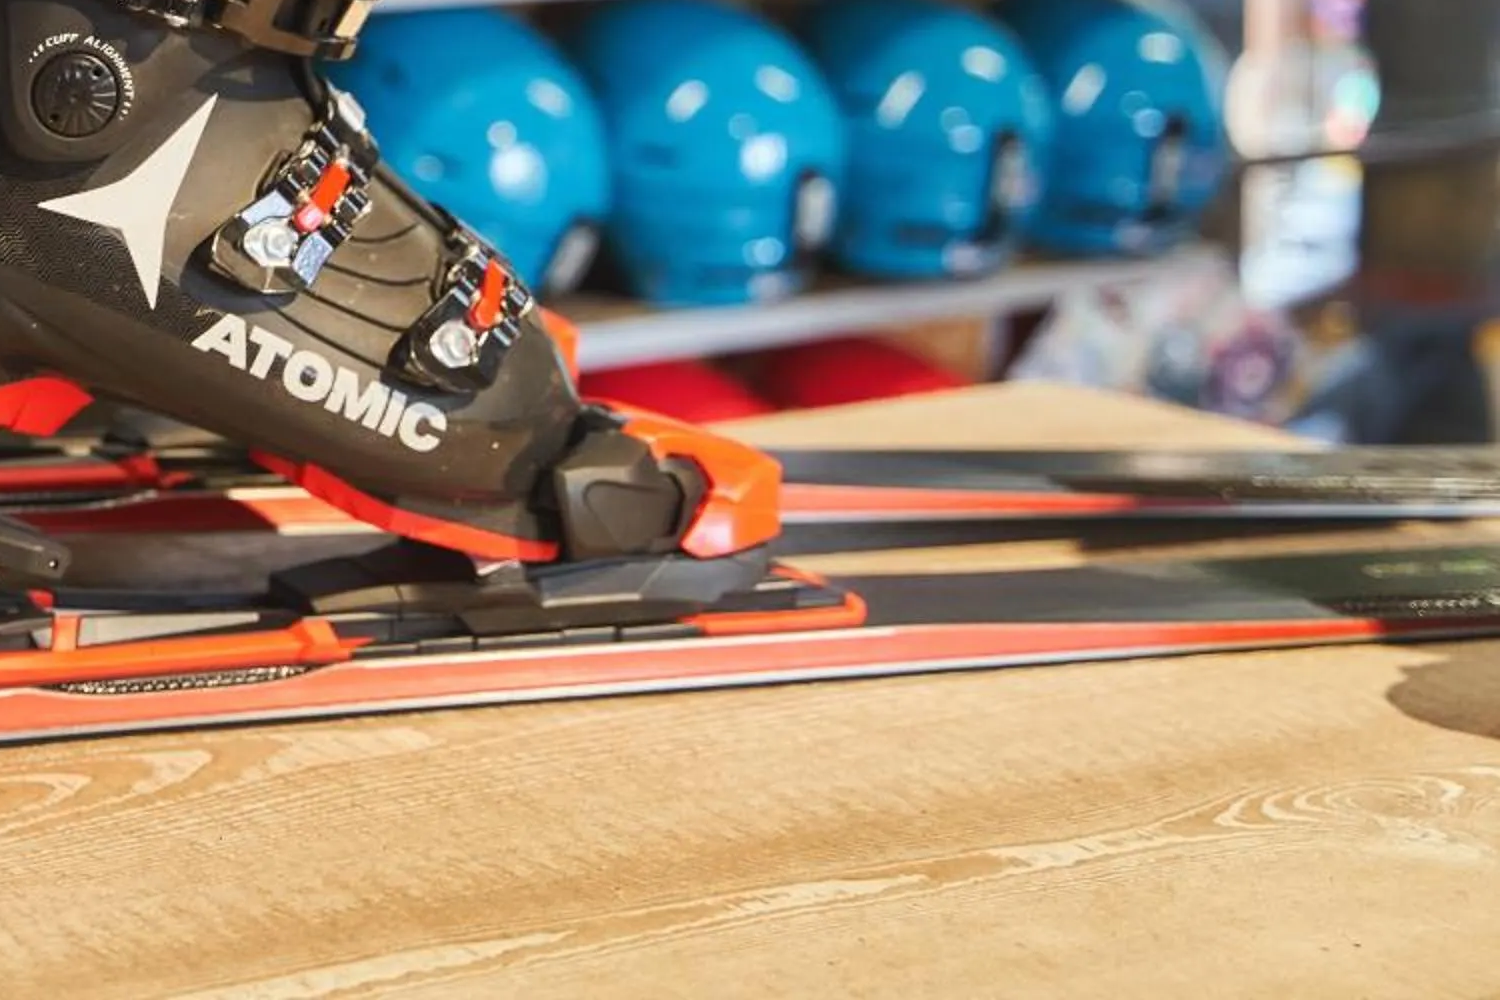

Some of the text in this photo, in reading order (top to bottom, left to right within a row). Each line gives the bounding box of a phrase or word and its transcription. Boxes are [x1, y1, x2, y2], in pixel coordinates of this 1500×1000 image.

[46, 32, 135, 101] CUFF ALIGNMENT
[190, 312, 448, 453] ATOMIC
